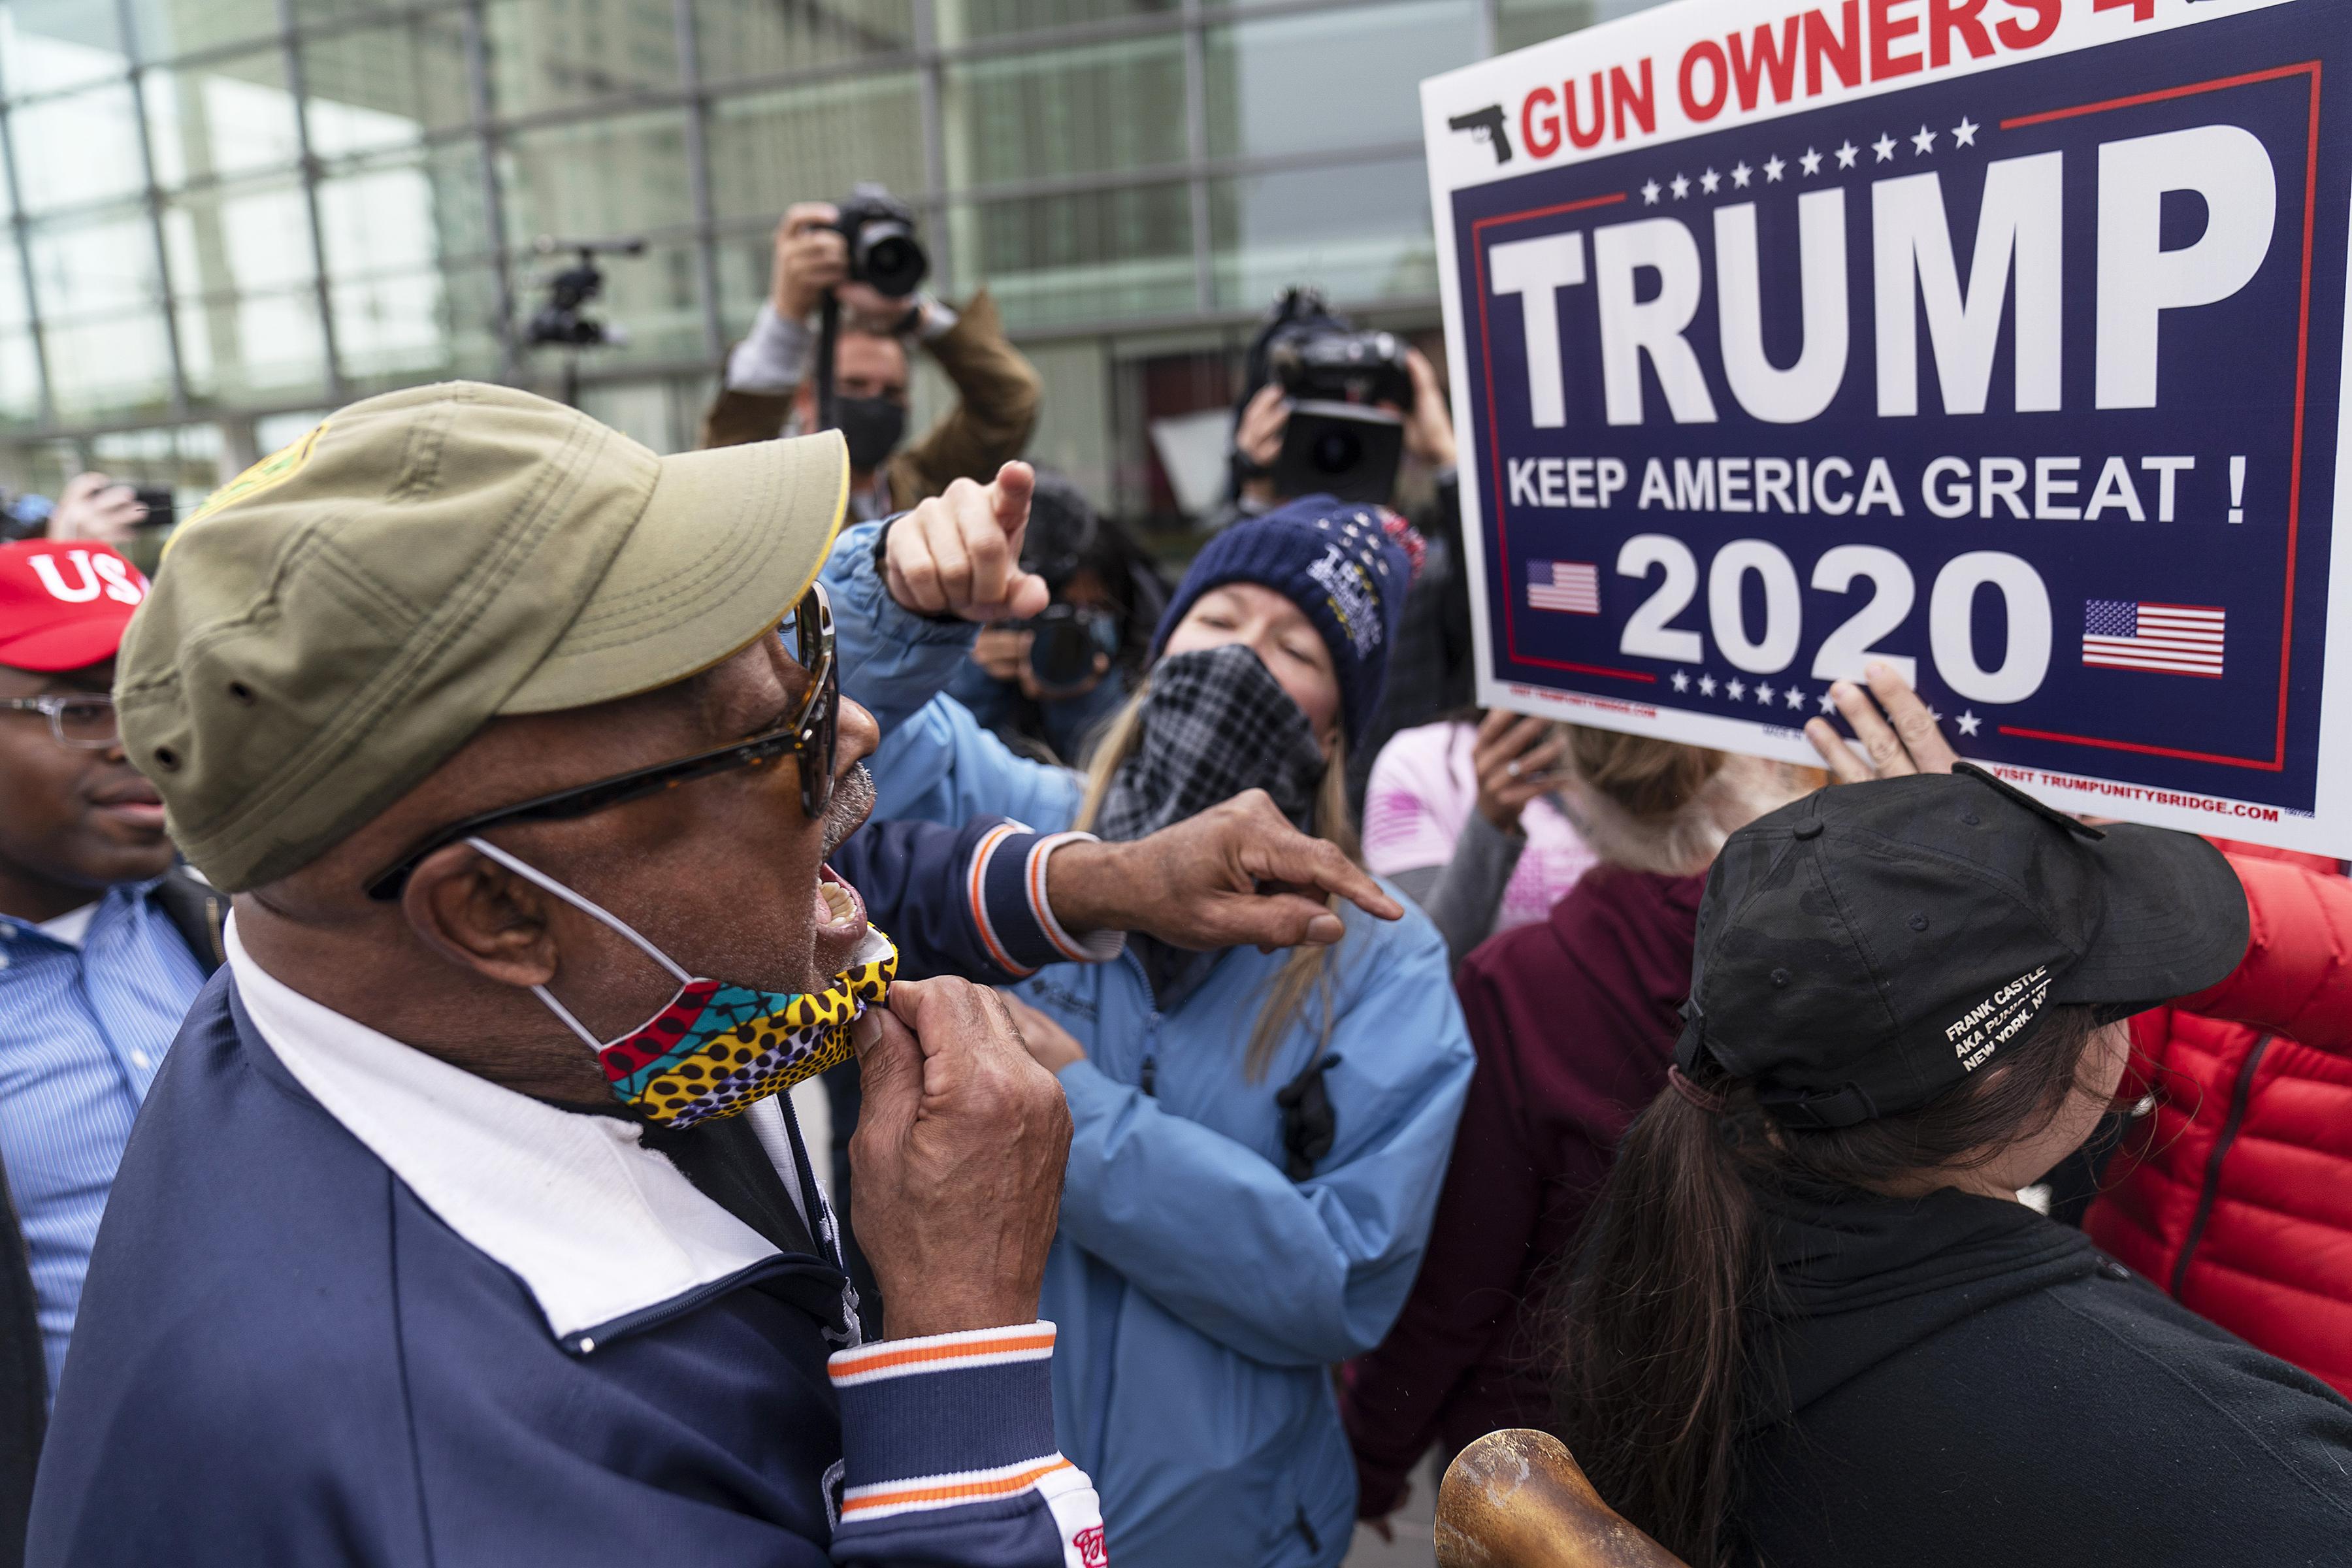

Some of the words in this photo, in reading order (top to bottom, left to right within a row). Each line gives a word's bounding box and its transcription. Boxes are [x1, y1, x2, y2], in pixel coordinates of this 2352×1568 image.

[1520, 57, 1657, 160] GUN
[1677, 0, 2063, 123] OWNERS
[1489, 124, 2277, 428] TRUMP
[1508, 458, 1627, 508] KEEP
[1639, 457, 1904, 516] AMERICA
[1921, 456, 2196, 523] GREAT
[2228, 455, 2247, 525] !
[27, 549, 152, 605] US
[1616, 534, 2053, 704] 2020
[1993, 767, 2035, 782] VISIT
[2042, 774, 2279, 823] TRUMPUNITYBRIDGE.COM
[1944, 999, 1996, 1042] FRANK
[1993, 964, 2048, 1005] CASTLE
[1962, 1039, 1995, 1072] NEW
[2032, 986, 2047, 1010] NY
[1955, 1030, 1985, 1058] AKA
